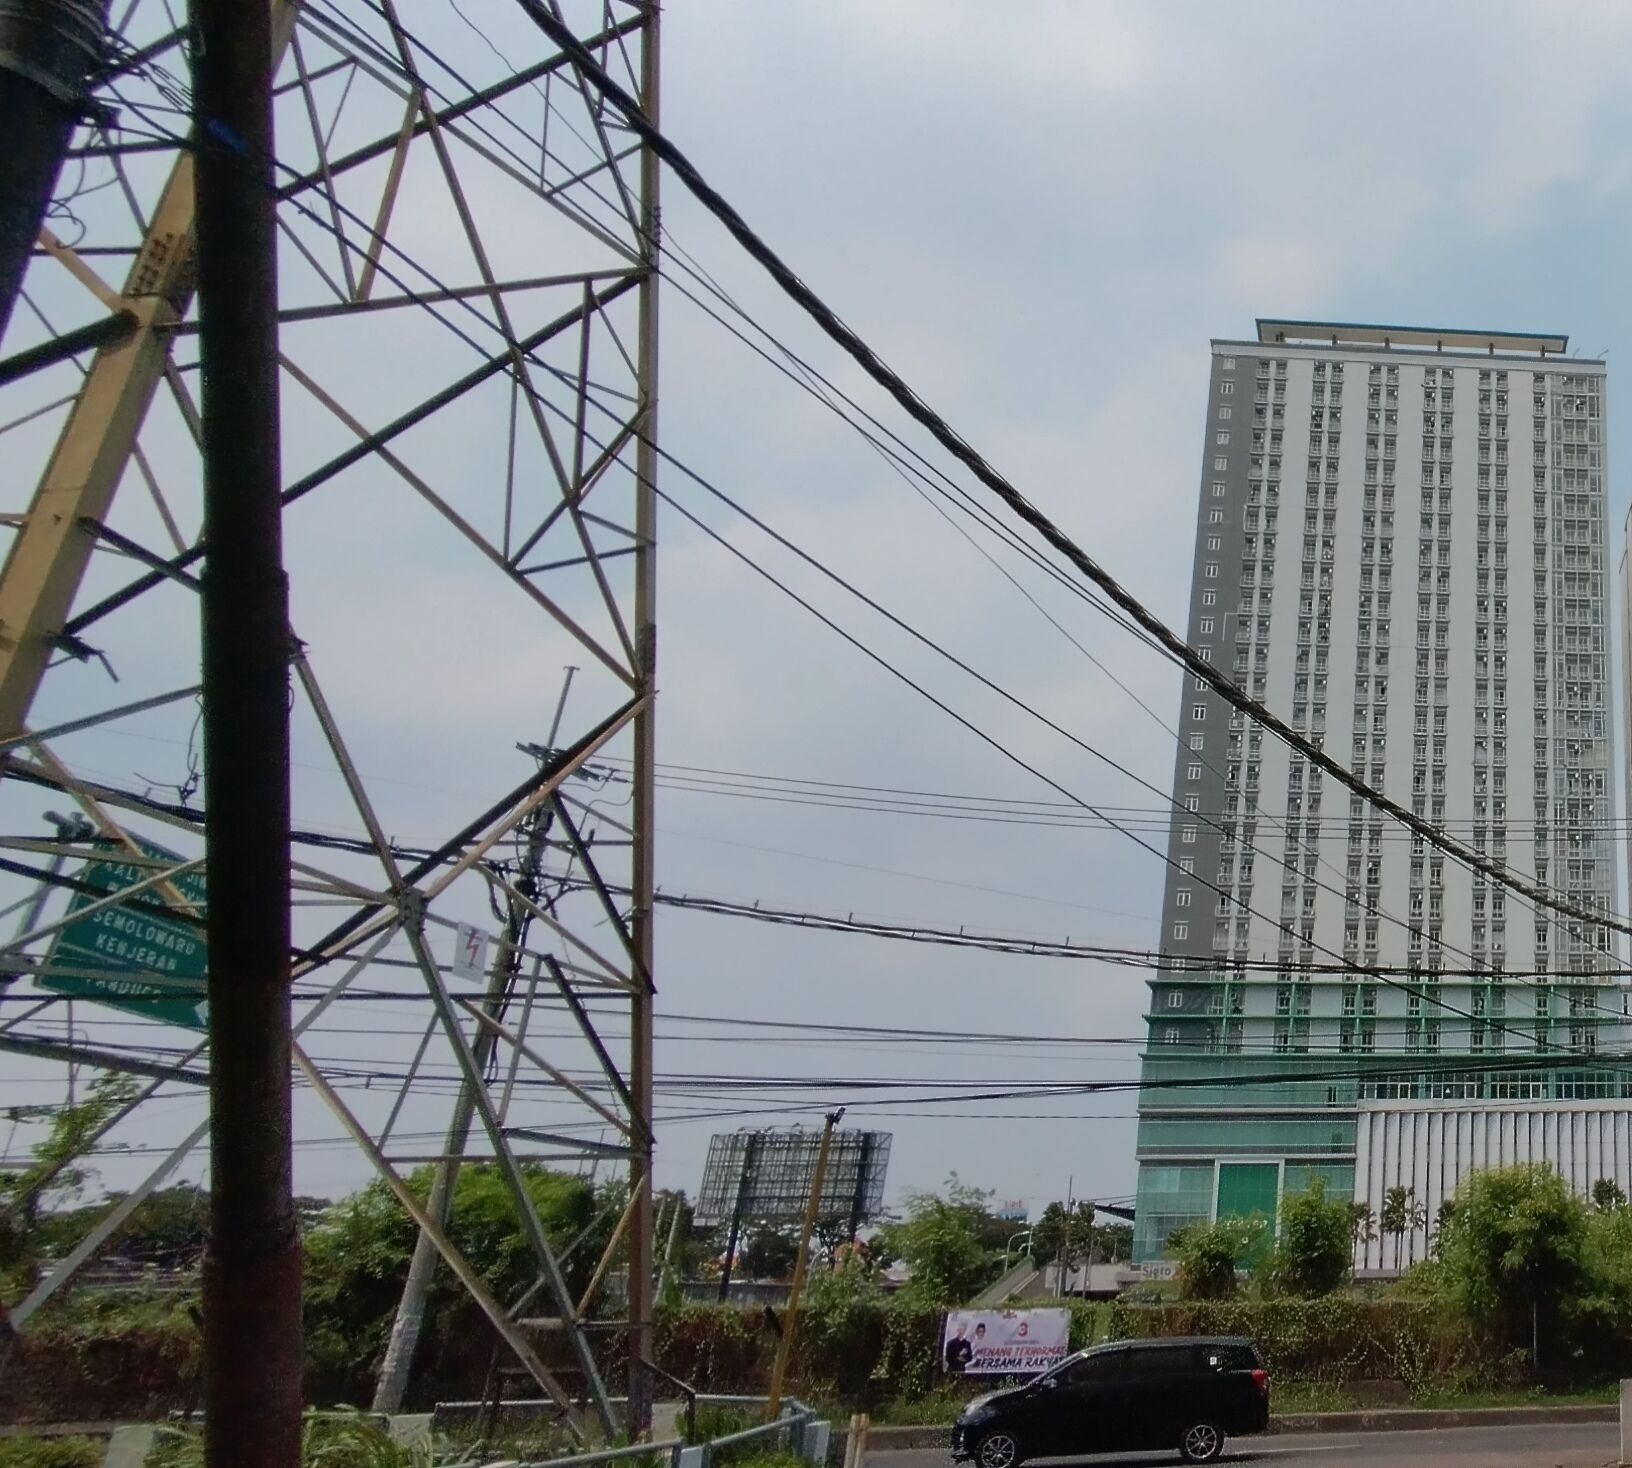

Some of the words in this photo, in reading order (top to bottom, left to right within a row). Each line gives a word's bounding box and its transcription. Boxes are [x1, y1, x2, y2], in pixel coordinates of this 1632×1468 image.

[92, 911, 196, 955] SEMOLOWARU
[95, 934, 178, 970] KENJERAN
[1018, 1322, 1028, 1337] 3
[974, 1357, 1022, 1369] BERSAMA
